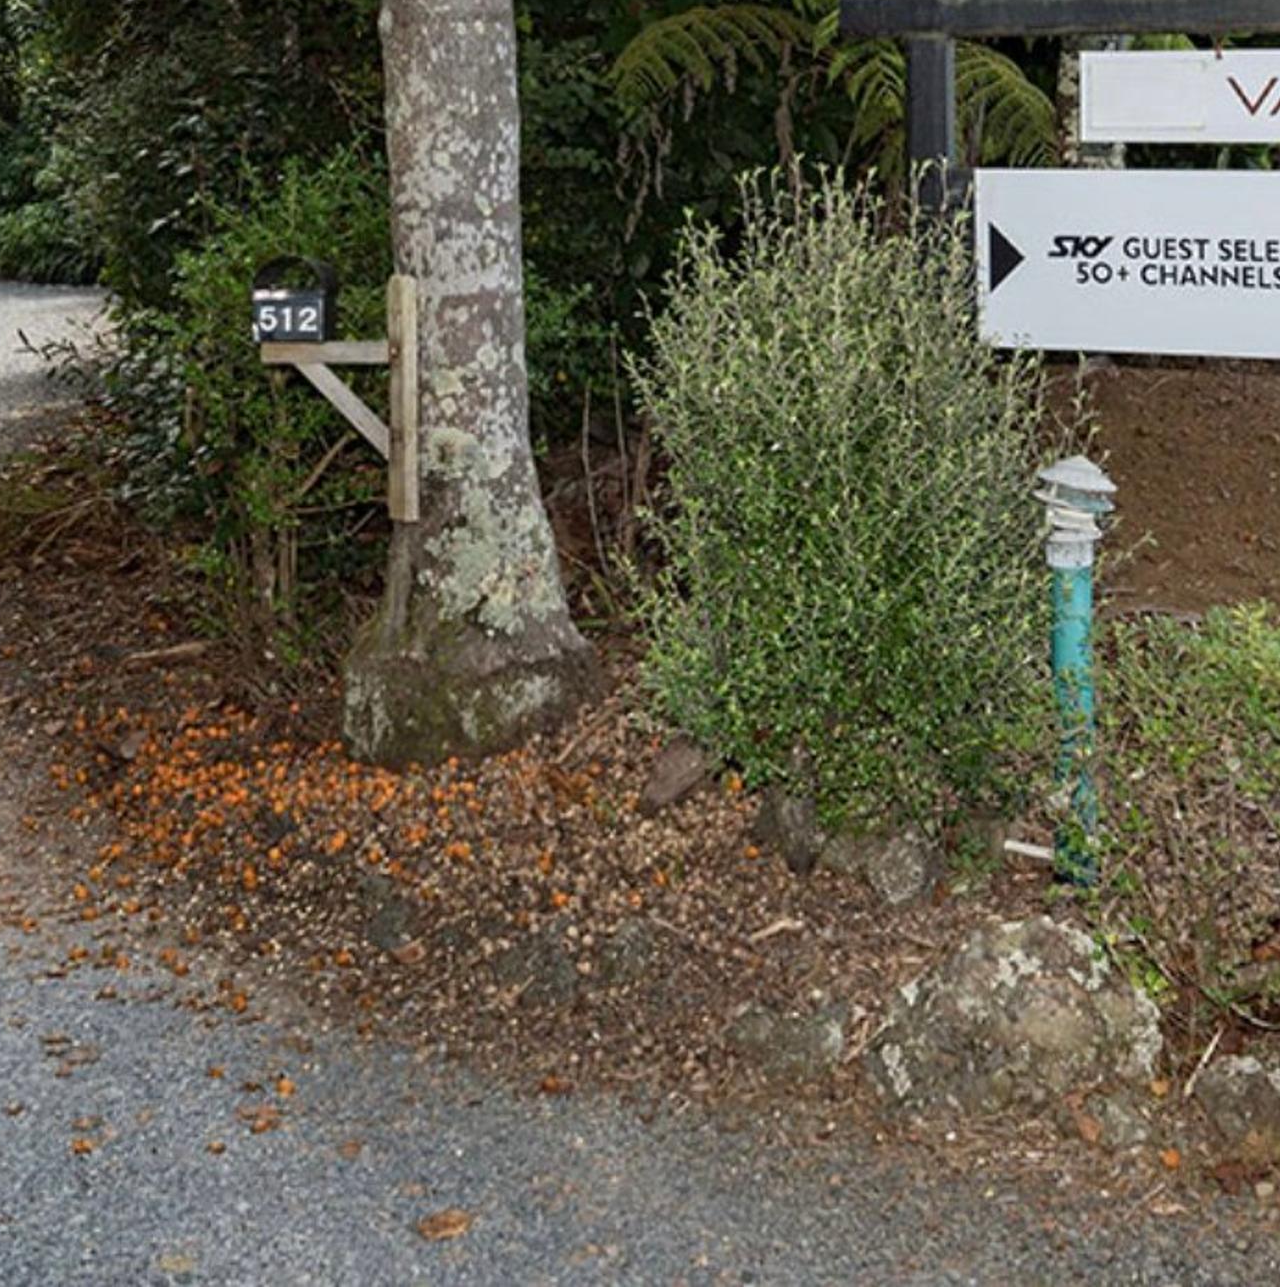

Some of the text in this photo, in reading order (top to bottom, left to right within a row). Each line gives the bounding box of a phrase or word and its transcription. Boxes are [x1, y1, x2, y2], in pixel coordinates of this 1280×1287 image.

[1048, 235, 1114, 258] SKY
[1122, 236, 1210, 261] GUEST
[259, 306, 318, 333] 512
